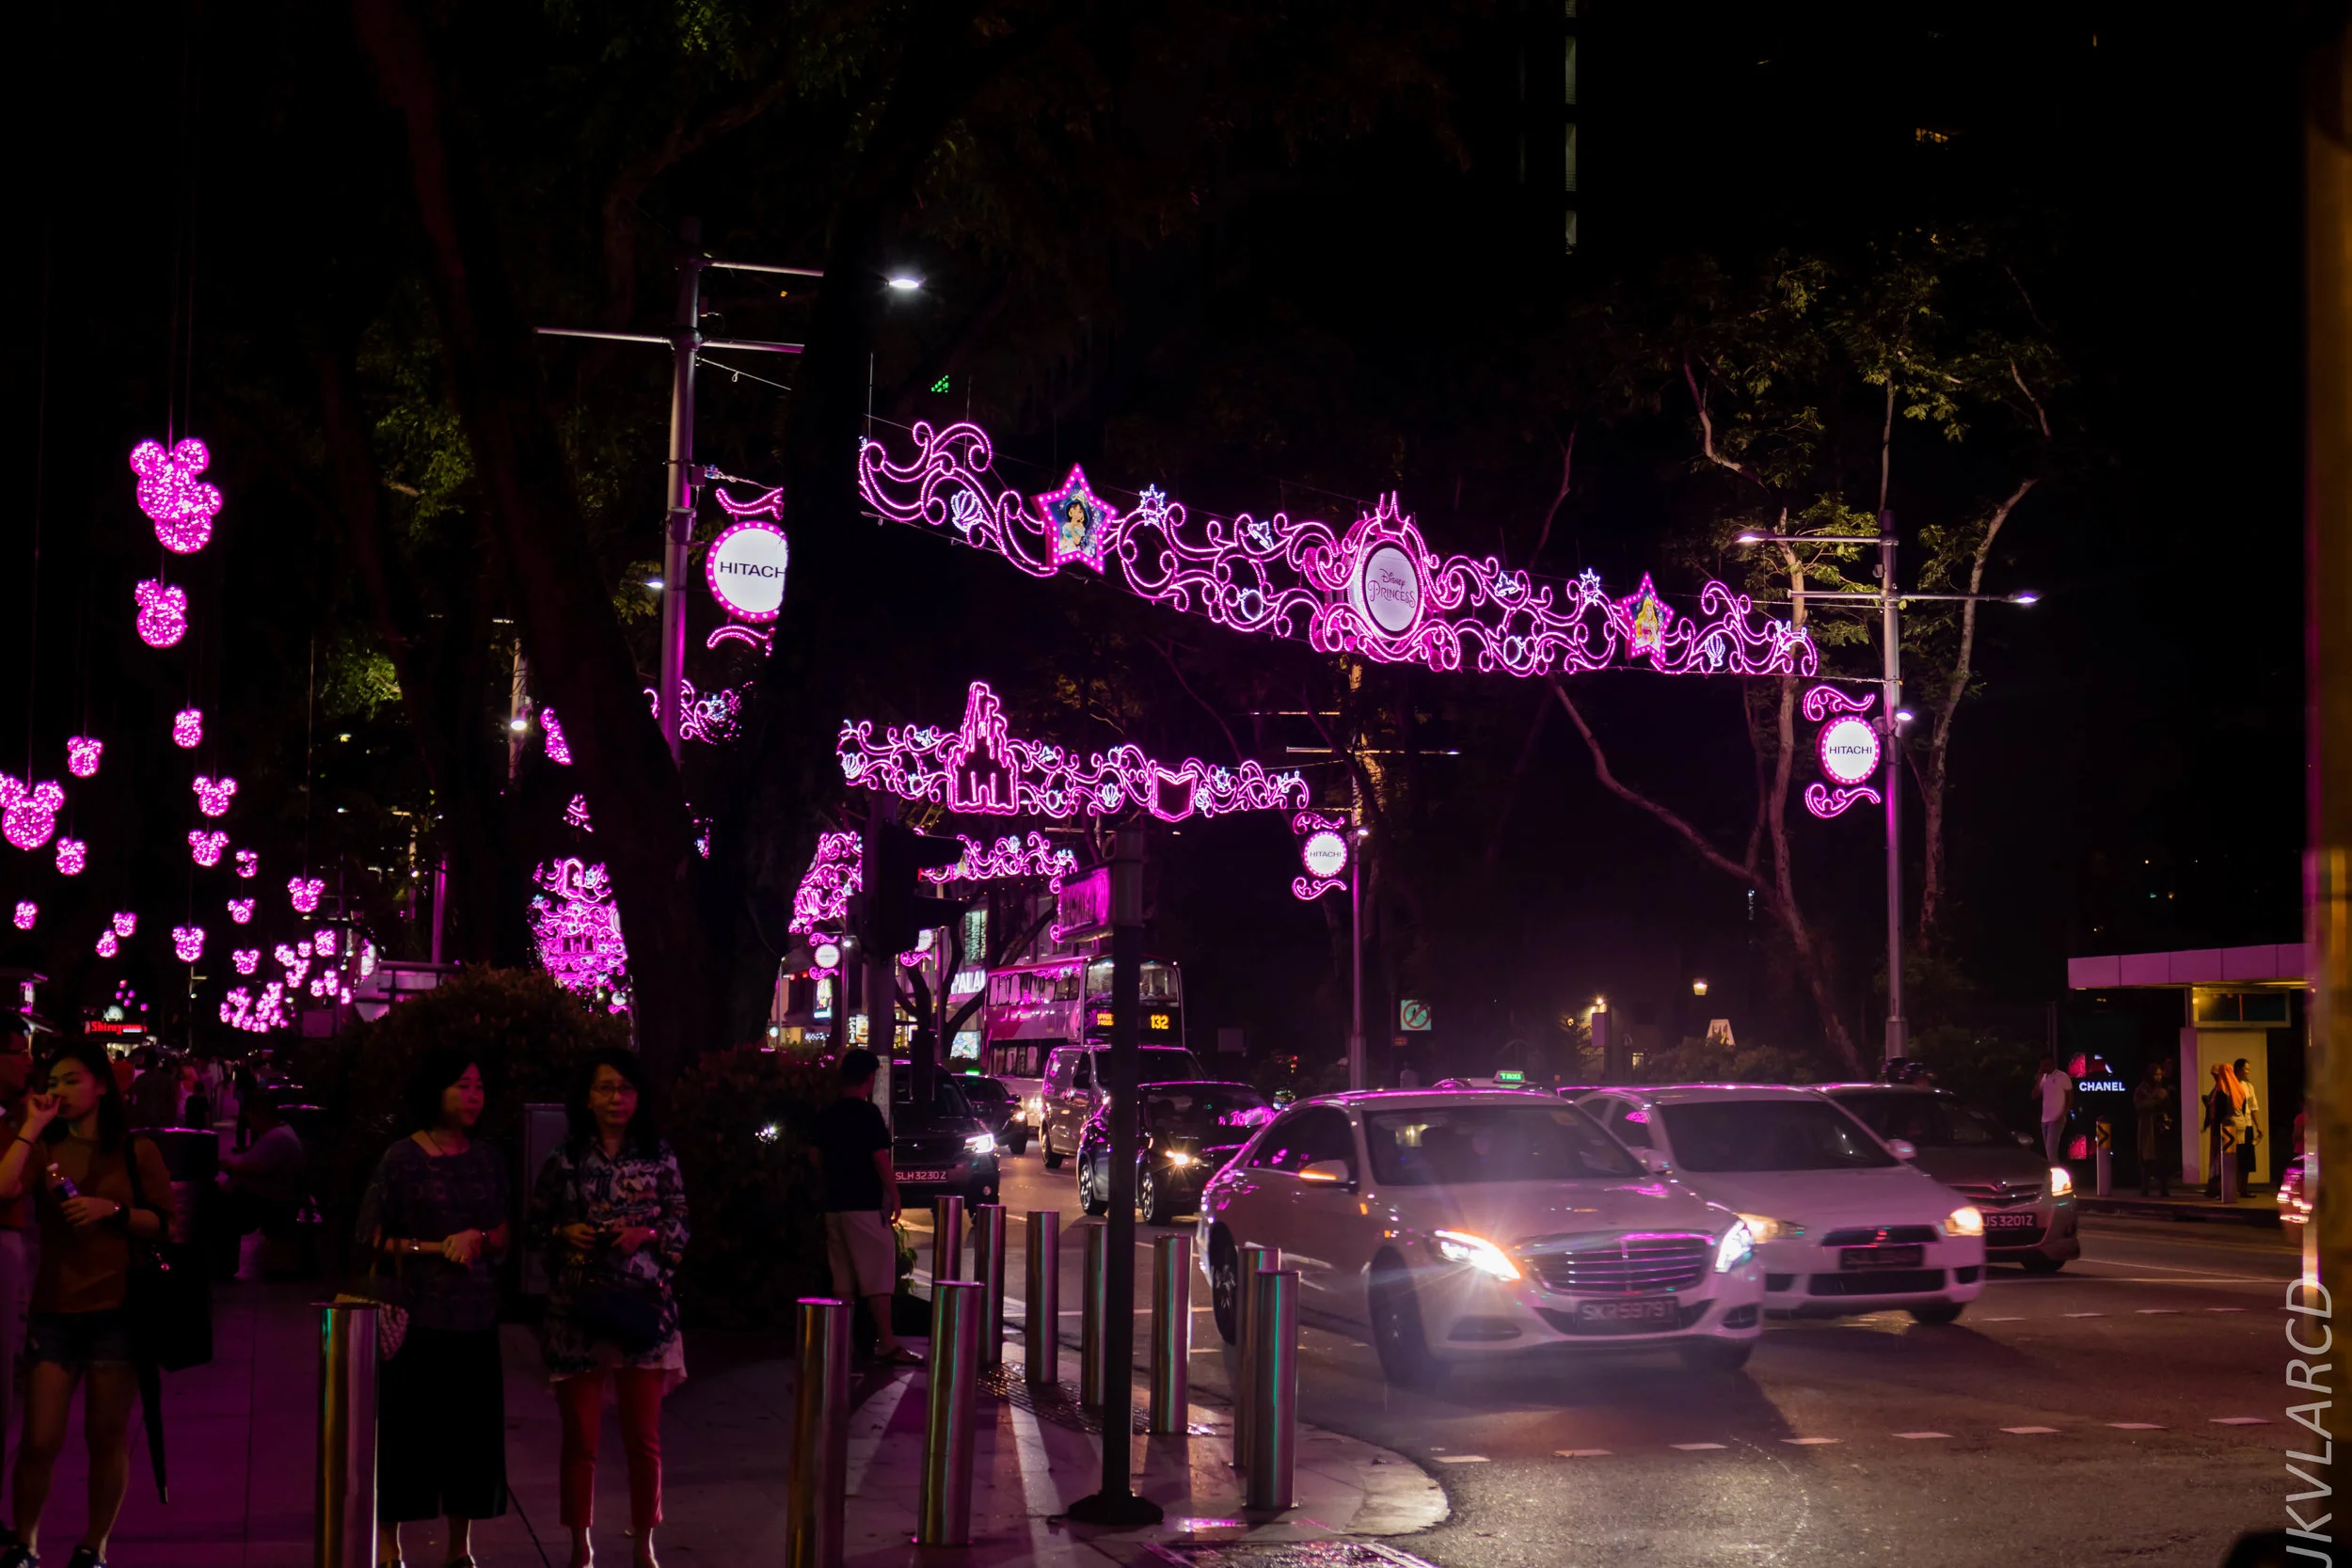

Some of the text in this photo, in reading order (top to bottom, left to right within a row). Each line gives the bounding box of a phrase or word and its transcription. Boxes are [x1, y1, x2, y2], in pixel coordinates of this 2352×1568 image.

[1829, 746, 1872, 754] HITACHI
[1151, 1014, 1169, 1030] 132
[1500, 1072, 1522, 1081] TAXI
[2078, 1082, 2125, 1092] CHANEL
[895, 1171, 946, 1180] SLH3230Z
